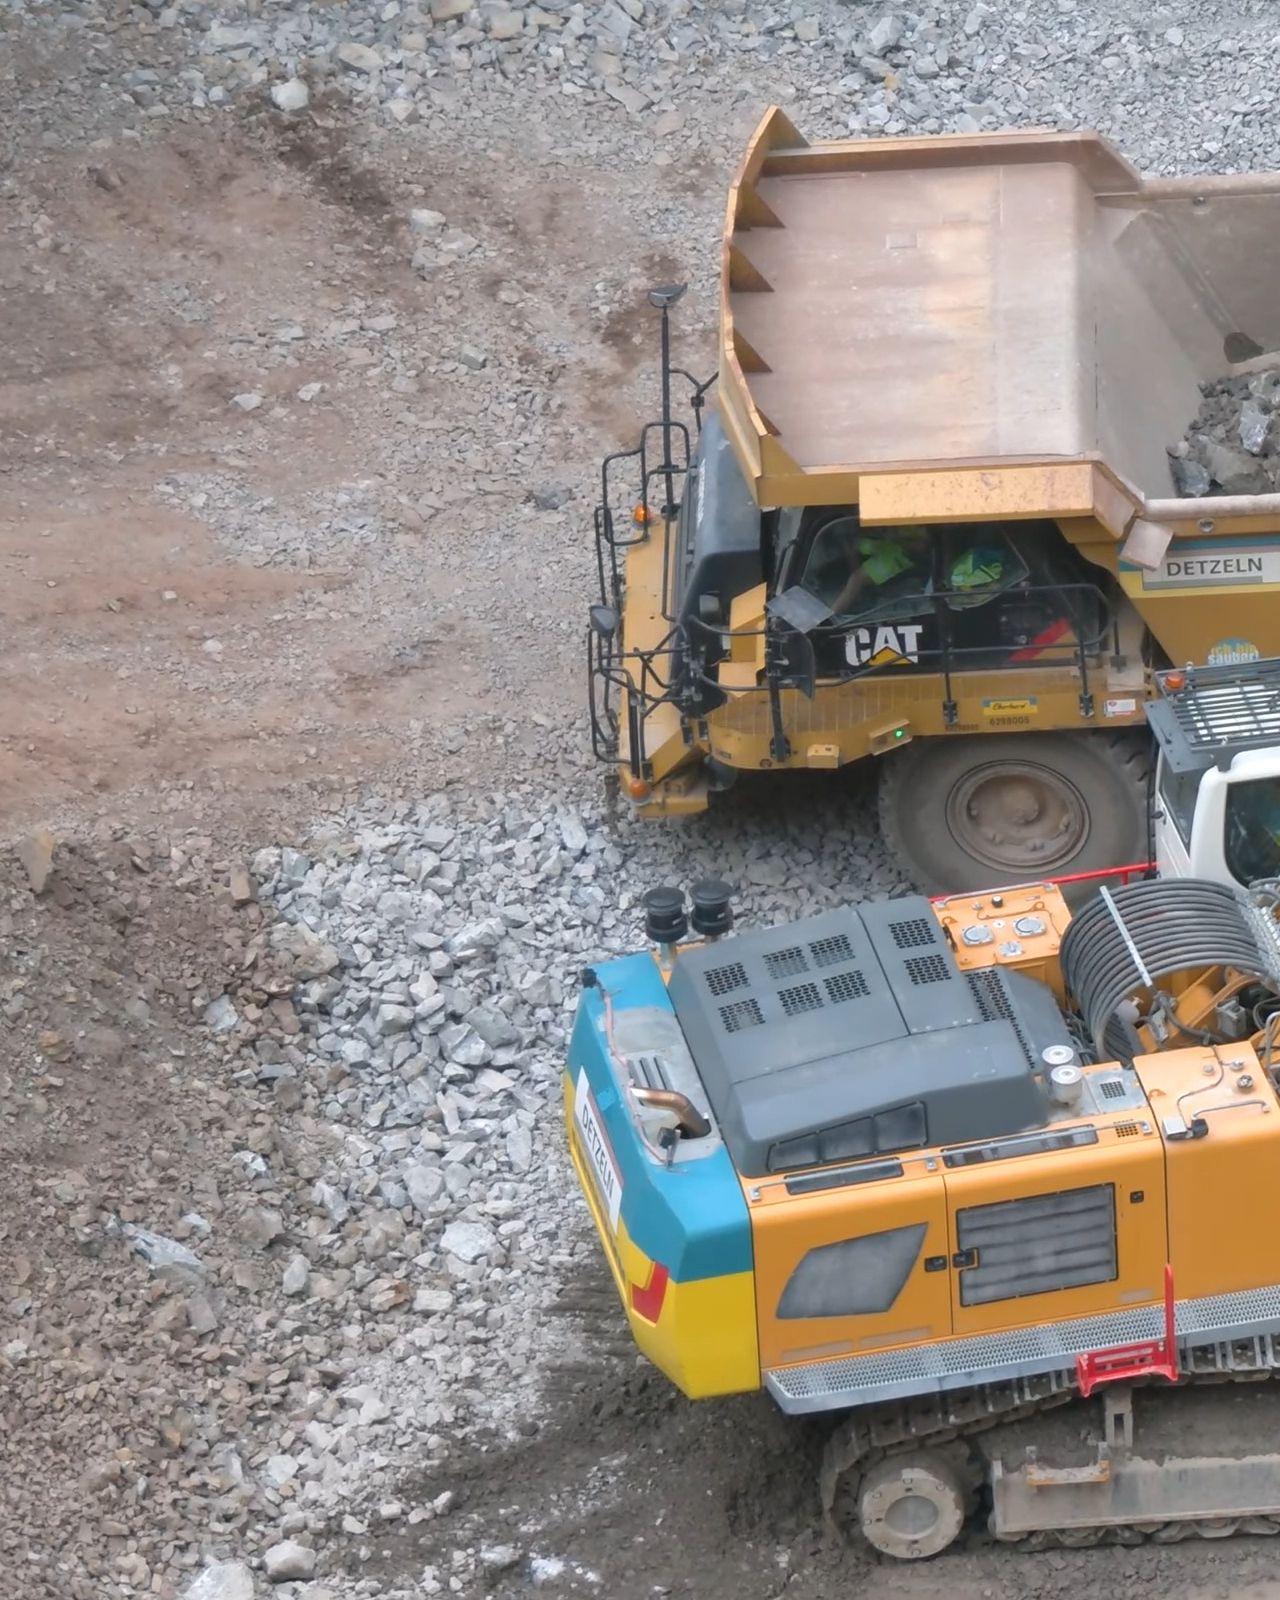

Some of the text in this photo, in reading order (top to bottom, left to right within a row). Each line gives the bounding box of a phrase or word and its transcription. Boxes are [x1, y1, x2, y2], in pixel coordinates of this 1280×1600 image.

[1166, 557, 1263, 577] DETZELN
[845, 625, 923, 667] CAT
[582, 1103, 615, 1200] DETZELN
